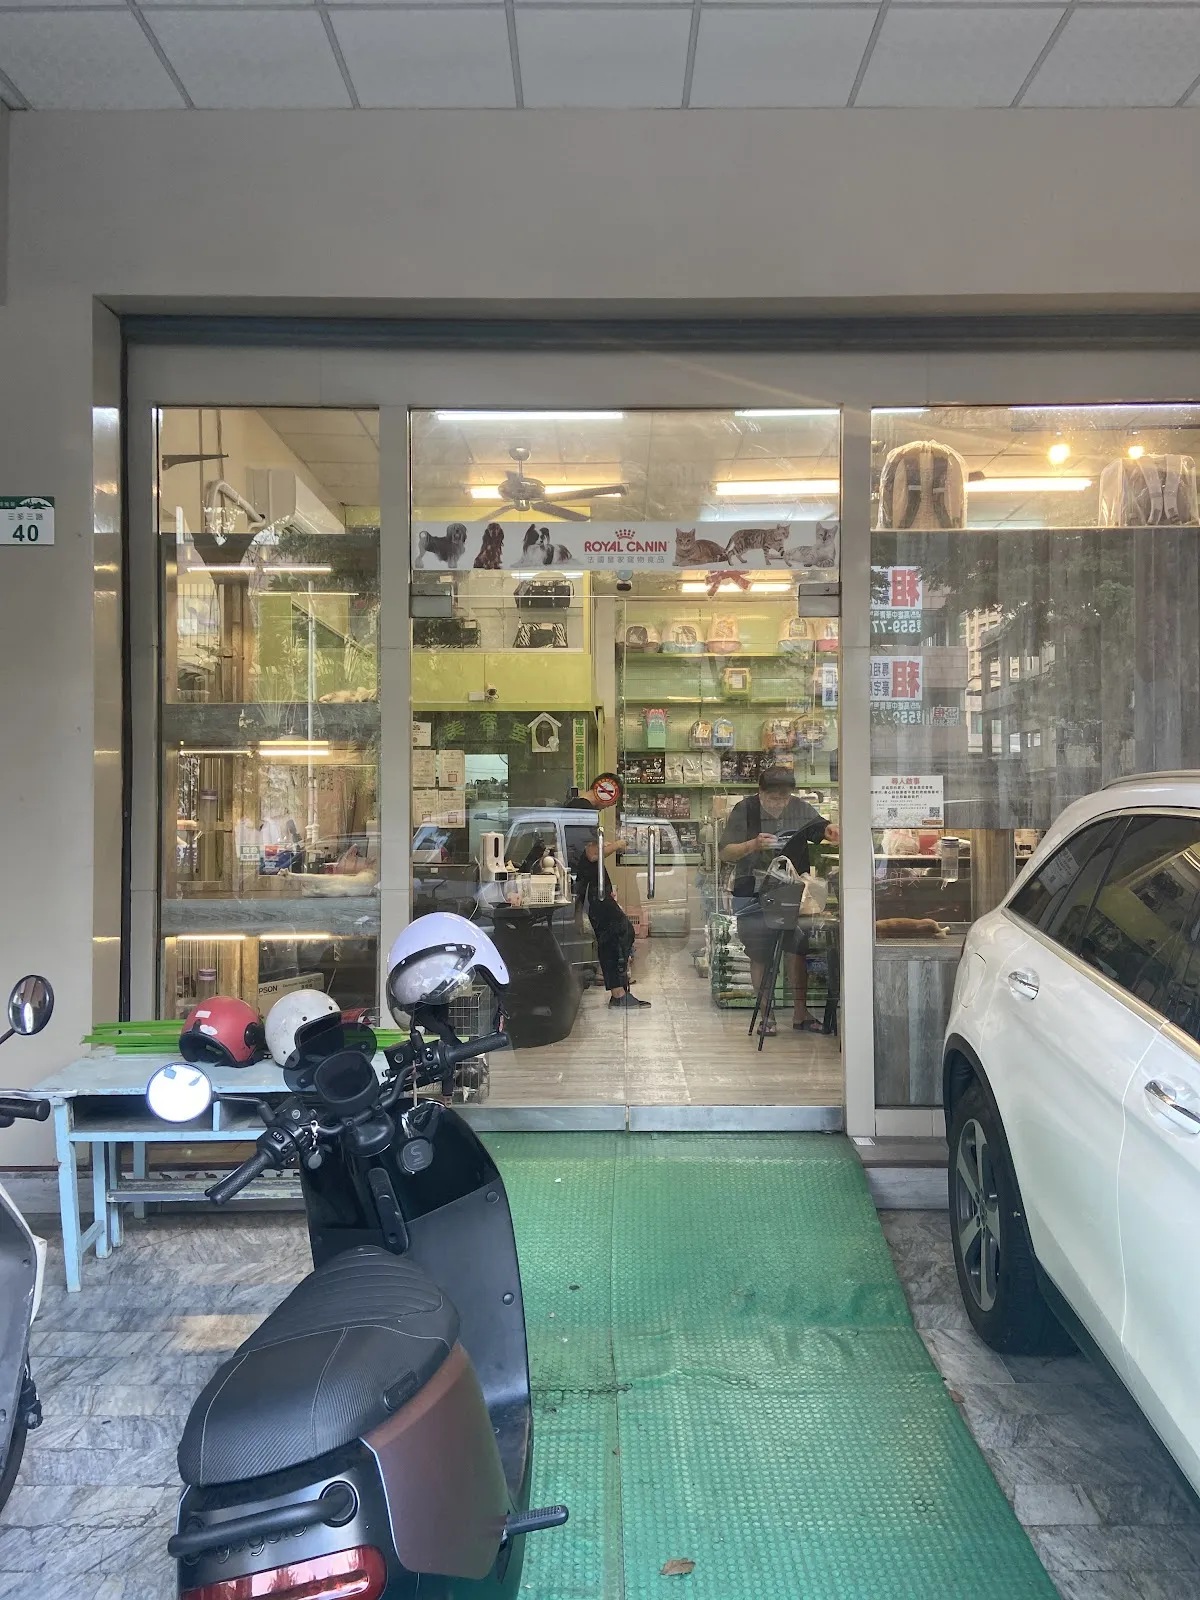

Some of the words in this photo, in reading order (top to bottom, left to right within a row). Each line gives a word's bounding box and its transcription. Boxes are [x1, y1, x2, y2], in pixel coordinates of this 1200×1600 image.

[12, 524, 39, 542] 40
[584, 541, 624, 552] ROYAL
[626, 541, 667, 552] CANIN
[587, 555, 665, 564] 法國皇家寵物食品
[258, 985, 278, 994] PSON
